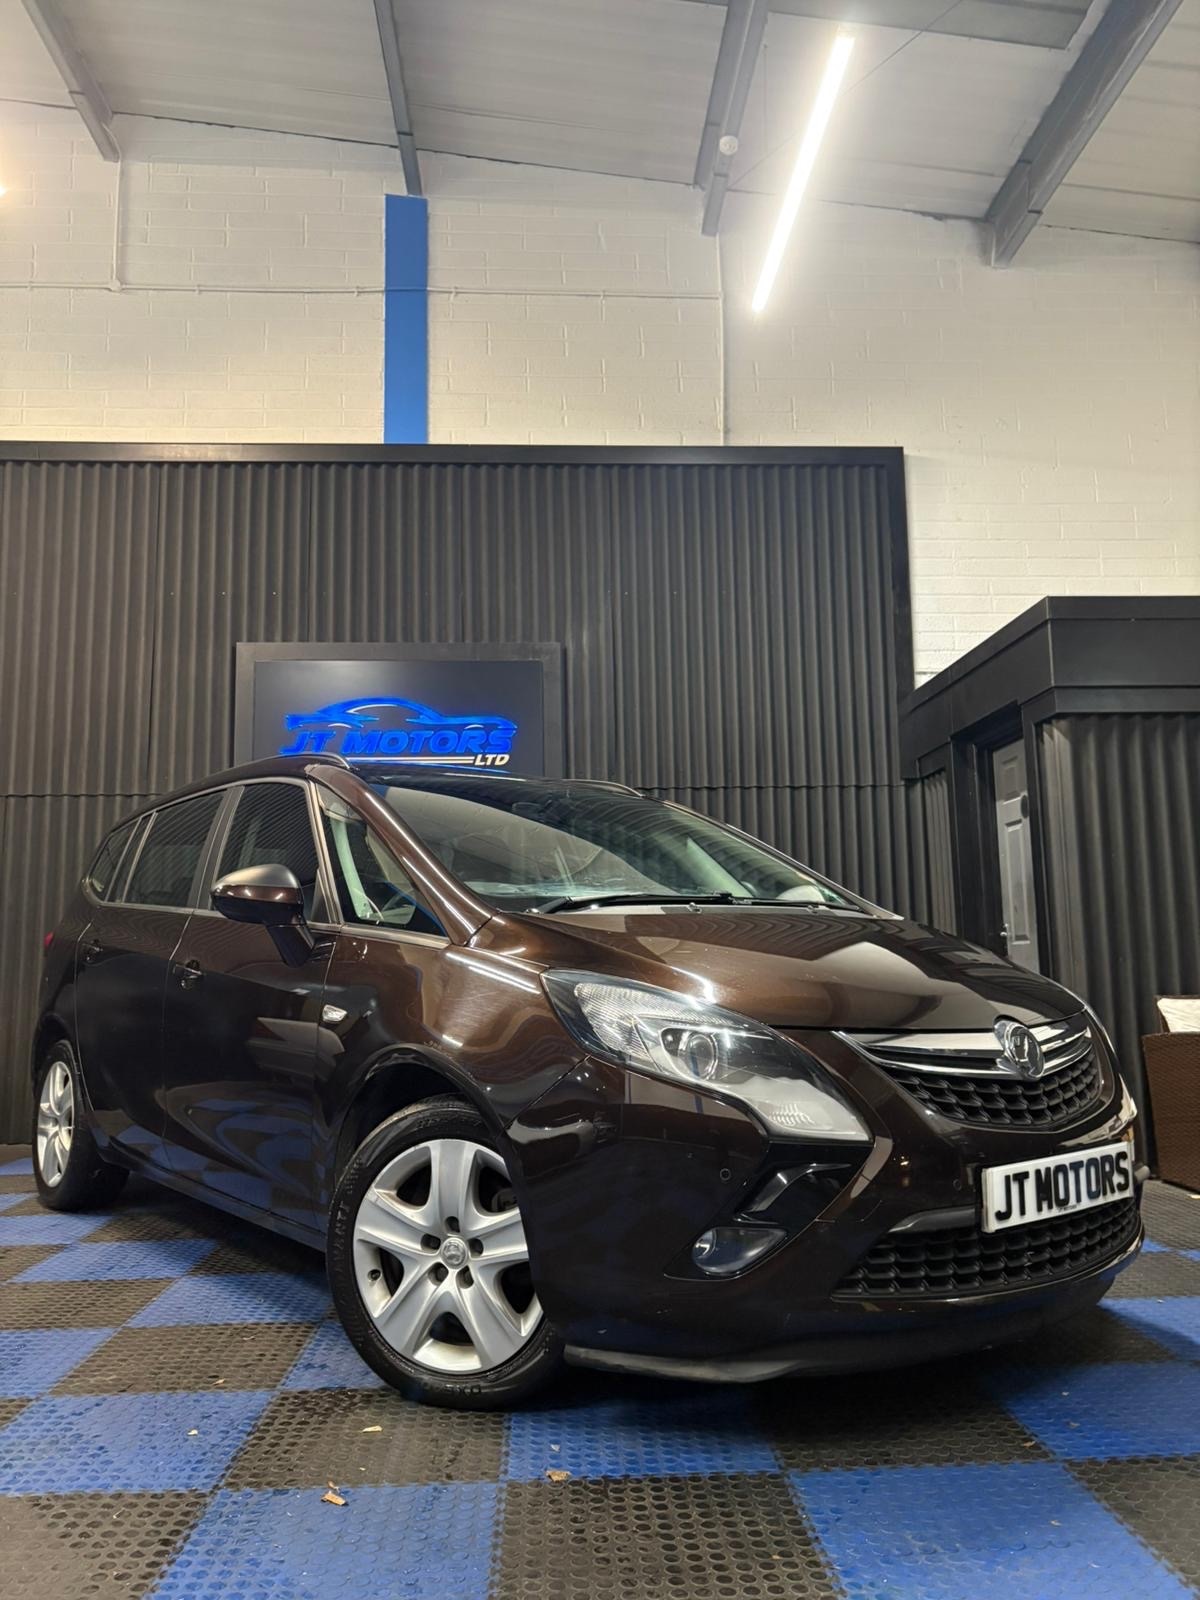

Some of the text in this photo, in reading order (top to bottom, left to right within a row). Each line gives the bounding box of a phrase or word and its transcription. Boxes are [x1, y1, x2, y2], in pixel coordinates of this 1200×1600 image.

[280, 730, 515, 754] JT MOTORS
[474, 754, 510, 766] LTD
[995, 1151, 1130, 1221] JT MOTORS
